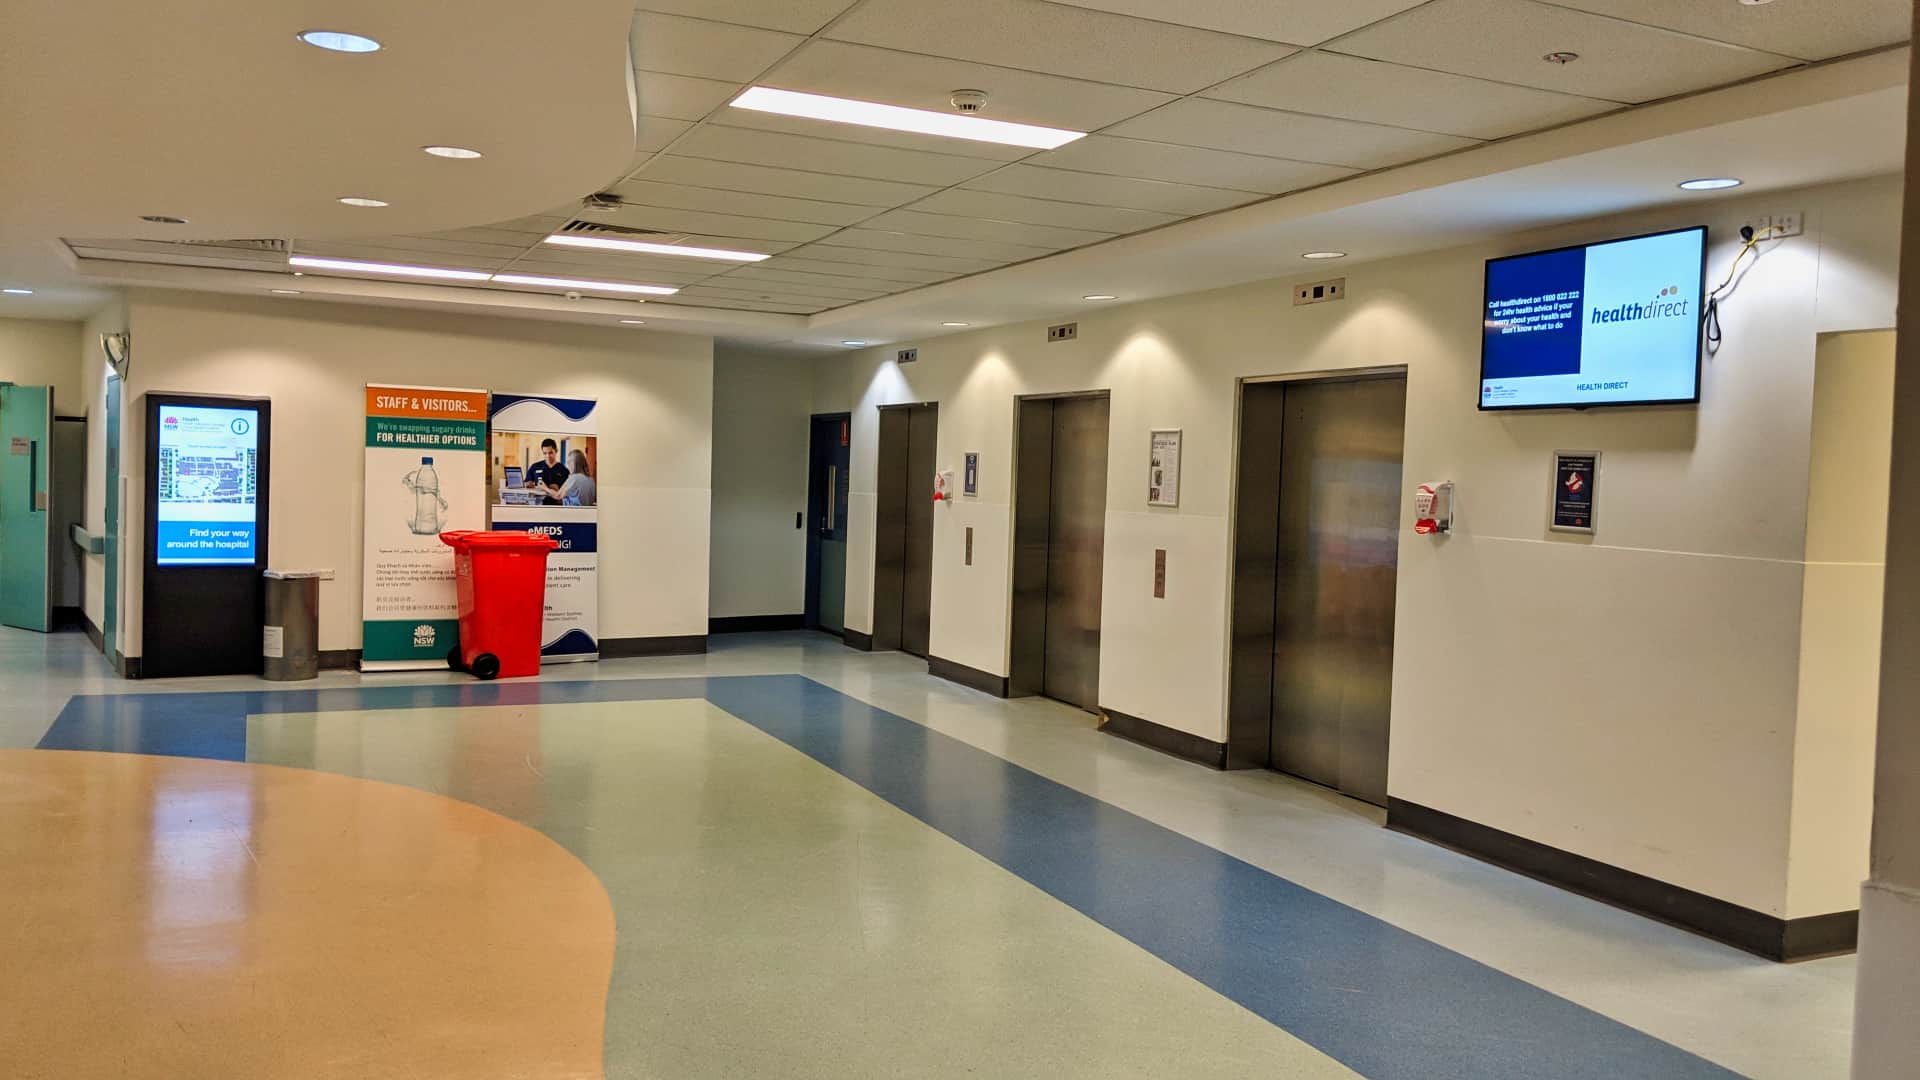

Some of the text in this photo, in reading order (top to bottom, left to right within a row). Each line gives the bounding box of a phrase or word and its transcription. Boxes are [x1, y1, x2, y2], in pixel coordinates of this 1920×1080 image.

[1500, 297, 1533, 308] healthdirect
[1515, 306, 1533, 315] health
[1533, 304, 1553, 313] advice
[1558, 303, 1573, 312] your
[1591, 299, 1688, 325] healthdirect
[1510, 316, 1527, 325] about
[1540, 313, 1560, 321] health
[1559, 312, 1572, 320] and
[1533, 322, 1548, 331] what
[1576, 382, 1629, 391] HEALTH DIRECT
[376, 396, 408, 409] STAFF
[411, 398, 419, 410] &
[456, 426, 476, 434] drinks
[376, 433, 477, 446] FOR HEALTHIER OPTIONS
[189, 528, 250, 539] Find your way
[528, 526, 563, 535] eMEDS
[166, 540, 249, 550] around the hospital
[414, 637, 435, 646] NSW
